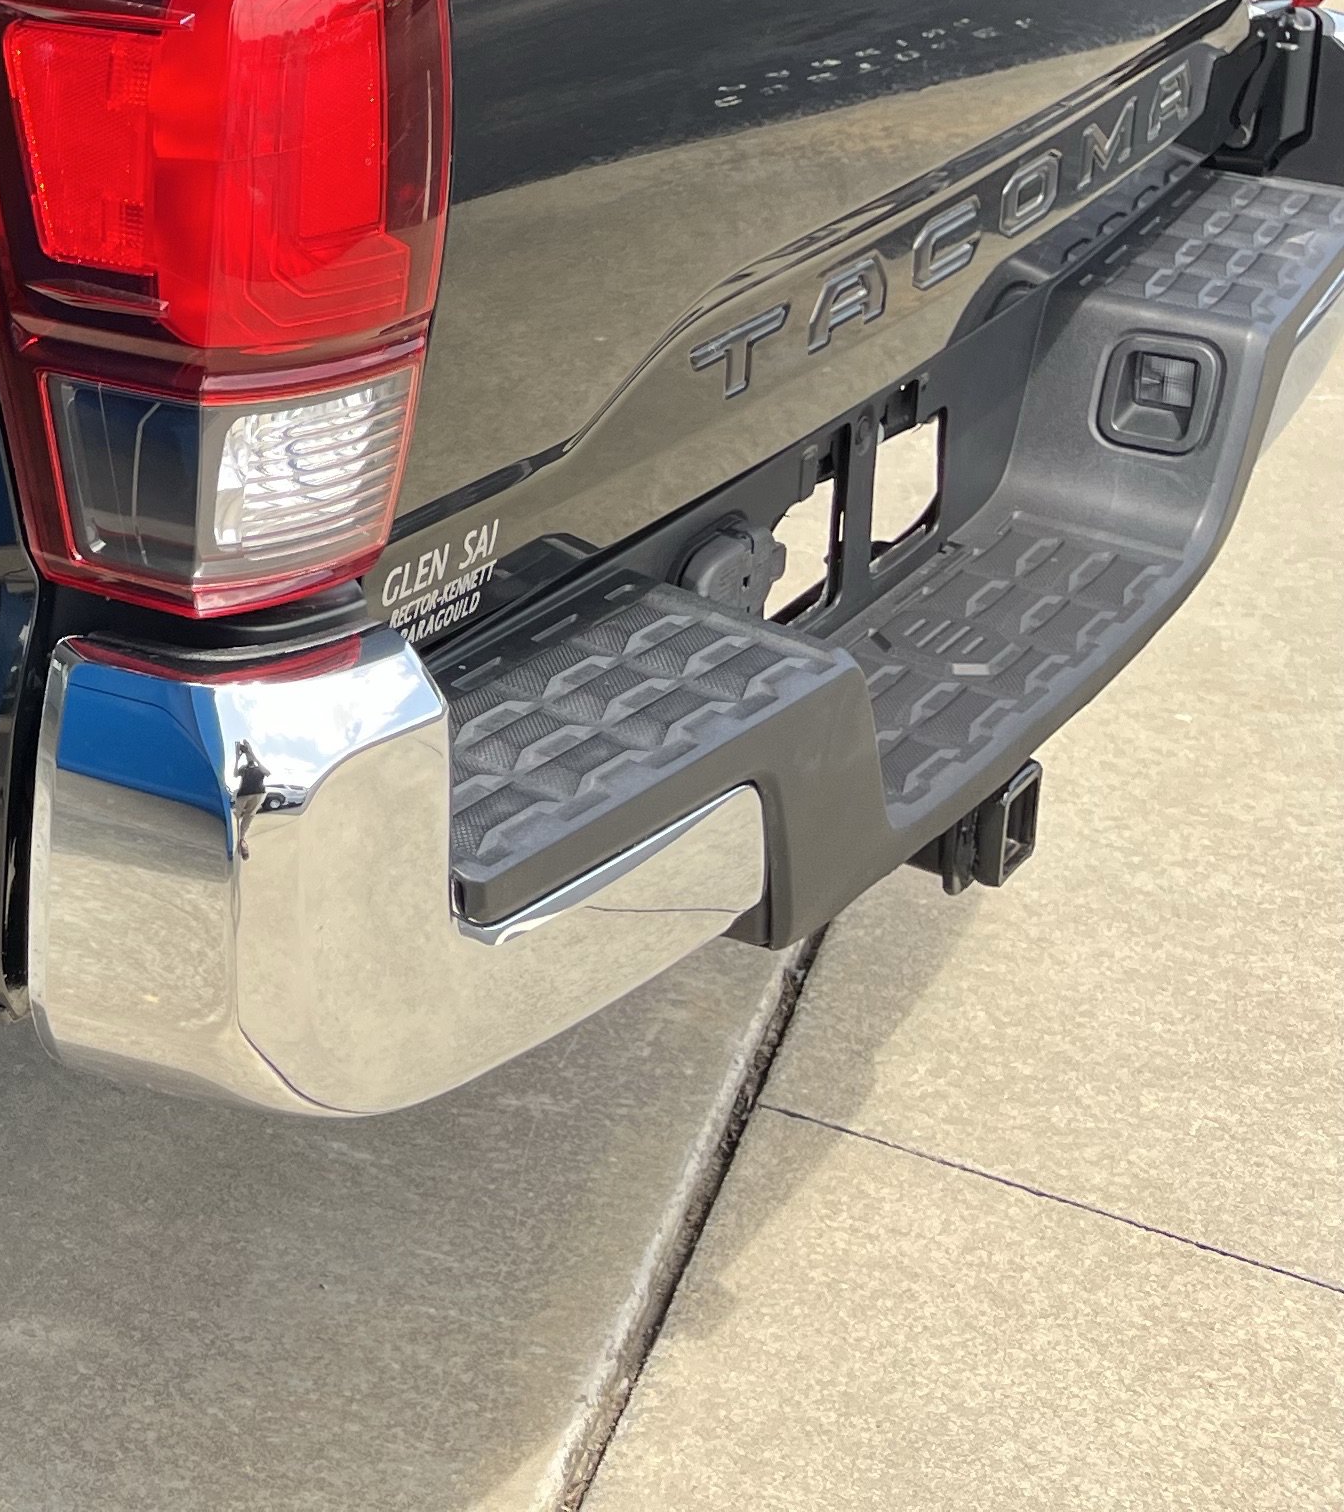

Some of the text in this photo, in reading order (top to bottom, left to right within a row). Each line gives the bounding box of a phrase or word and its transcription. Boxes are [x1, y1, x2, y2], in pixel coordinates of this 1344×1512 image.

[688, 59, 1192, 400] TACOMA
[381, 518, 500, 607] GLEN SAI
[389, 558, 498, 630] RECTOR-KENNETT
[400, 591, 481, 644] PARAGOULD
